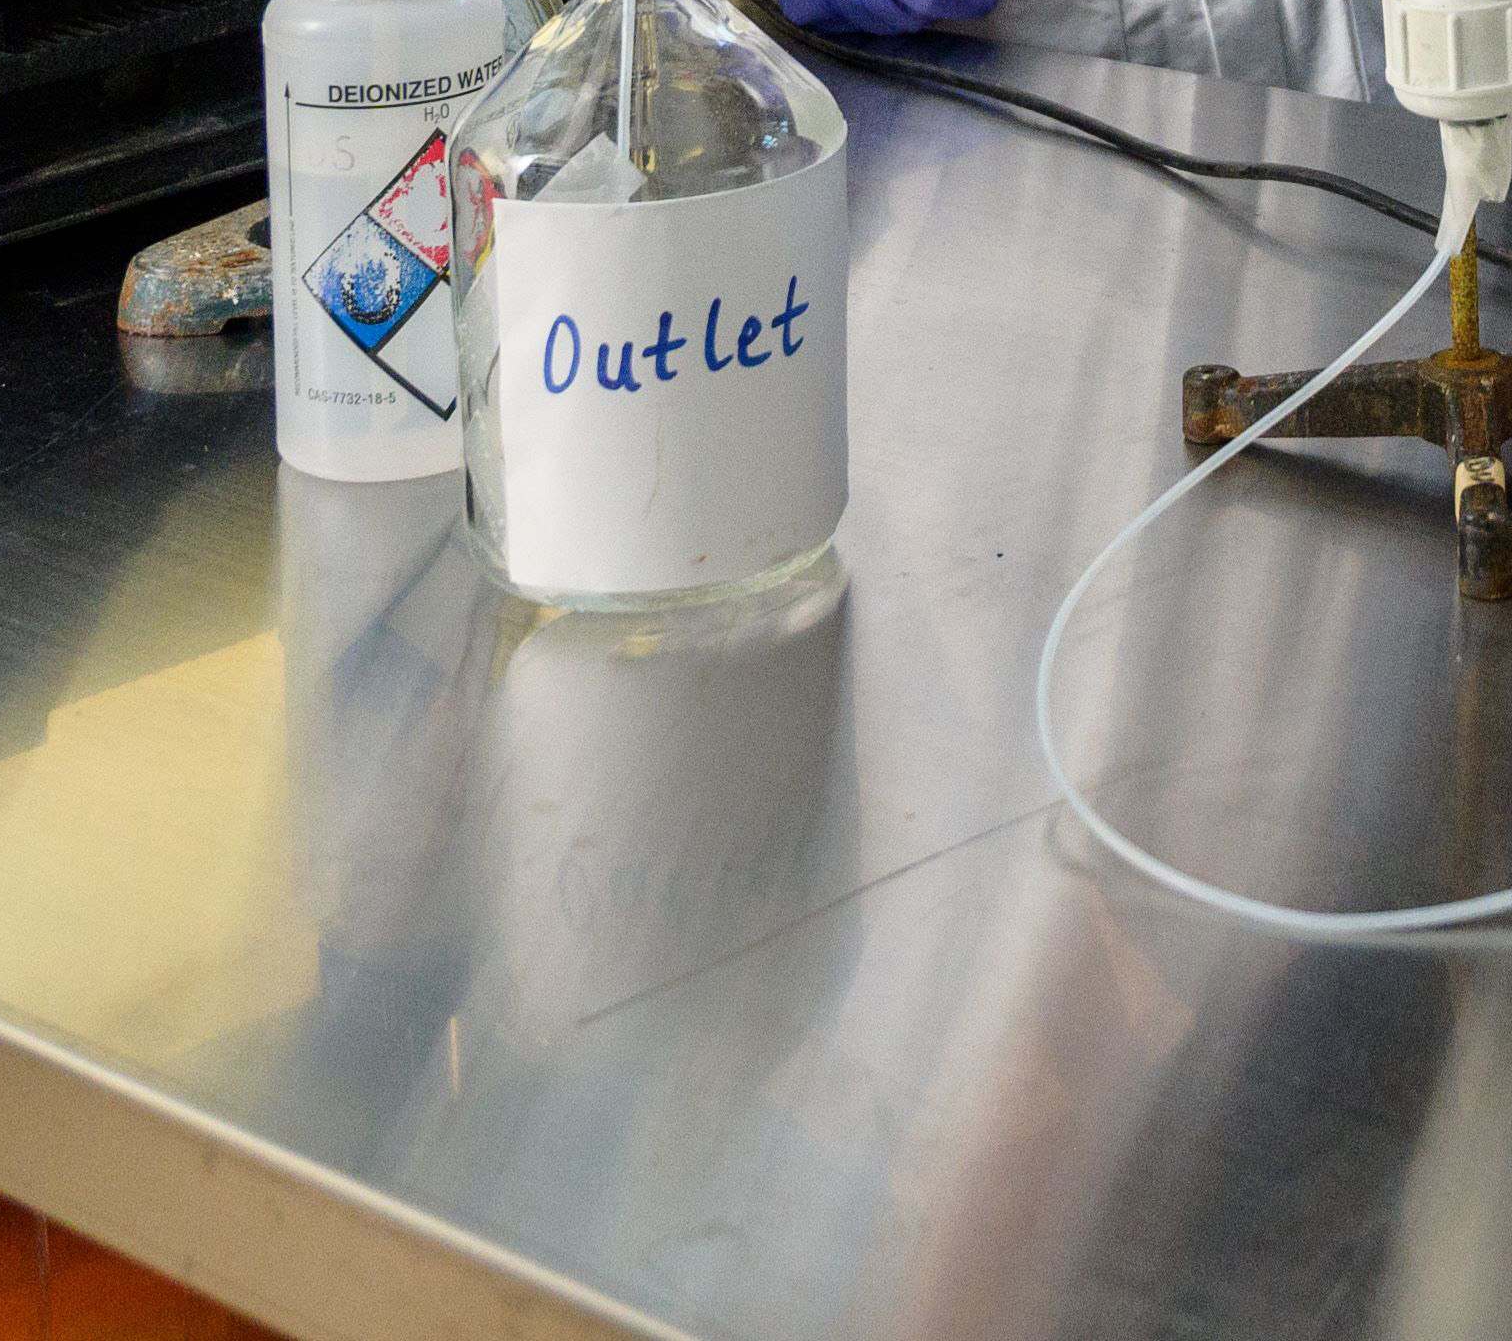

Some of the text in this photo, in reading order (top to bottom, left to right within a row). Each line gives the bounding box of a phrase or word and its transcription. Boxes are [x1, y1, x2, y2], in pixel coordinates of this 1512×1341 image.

[328, 76, 452, 103] DEIONIZED
[543, 274, 810, 395] Outlet
[307, 387, 397, 406] CAS-7732-18-5
